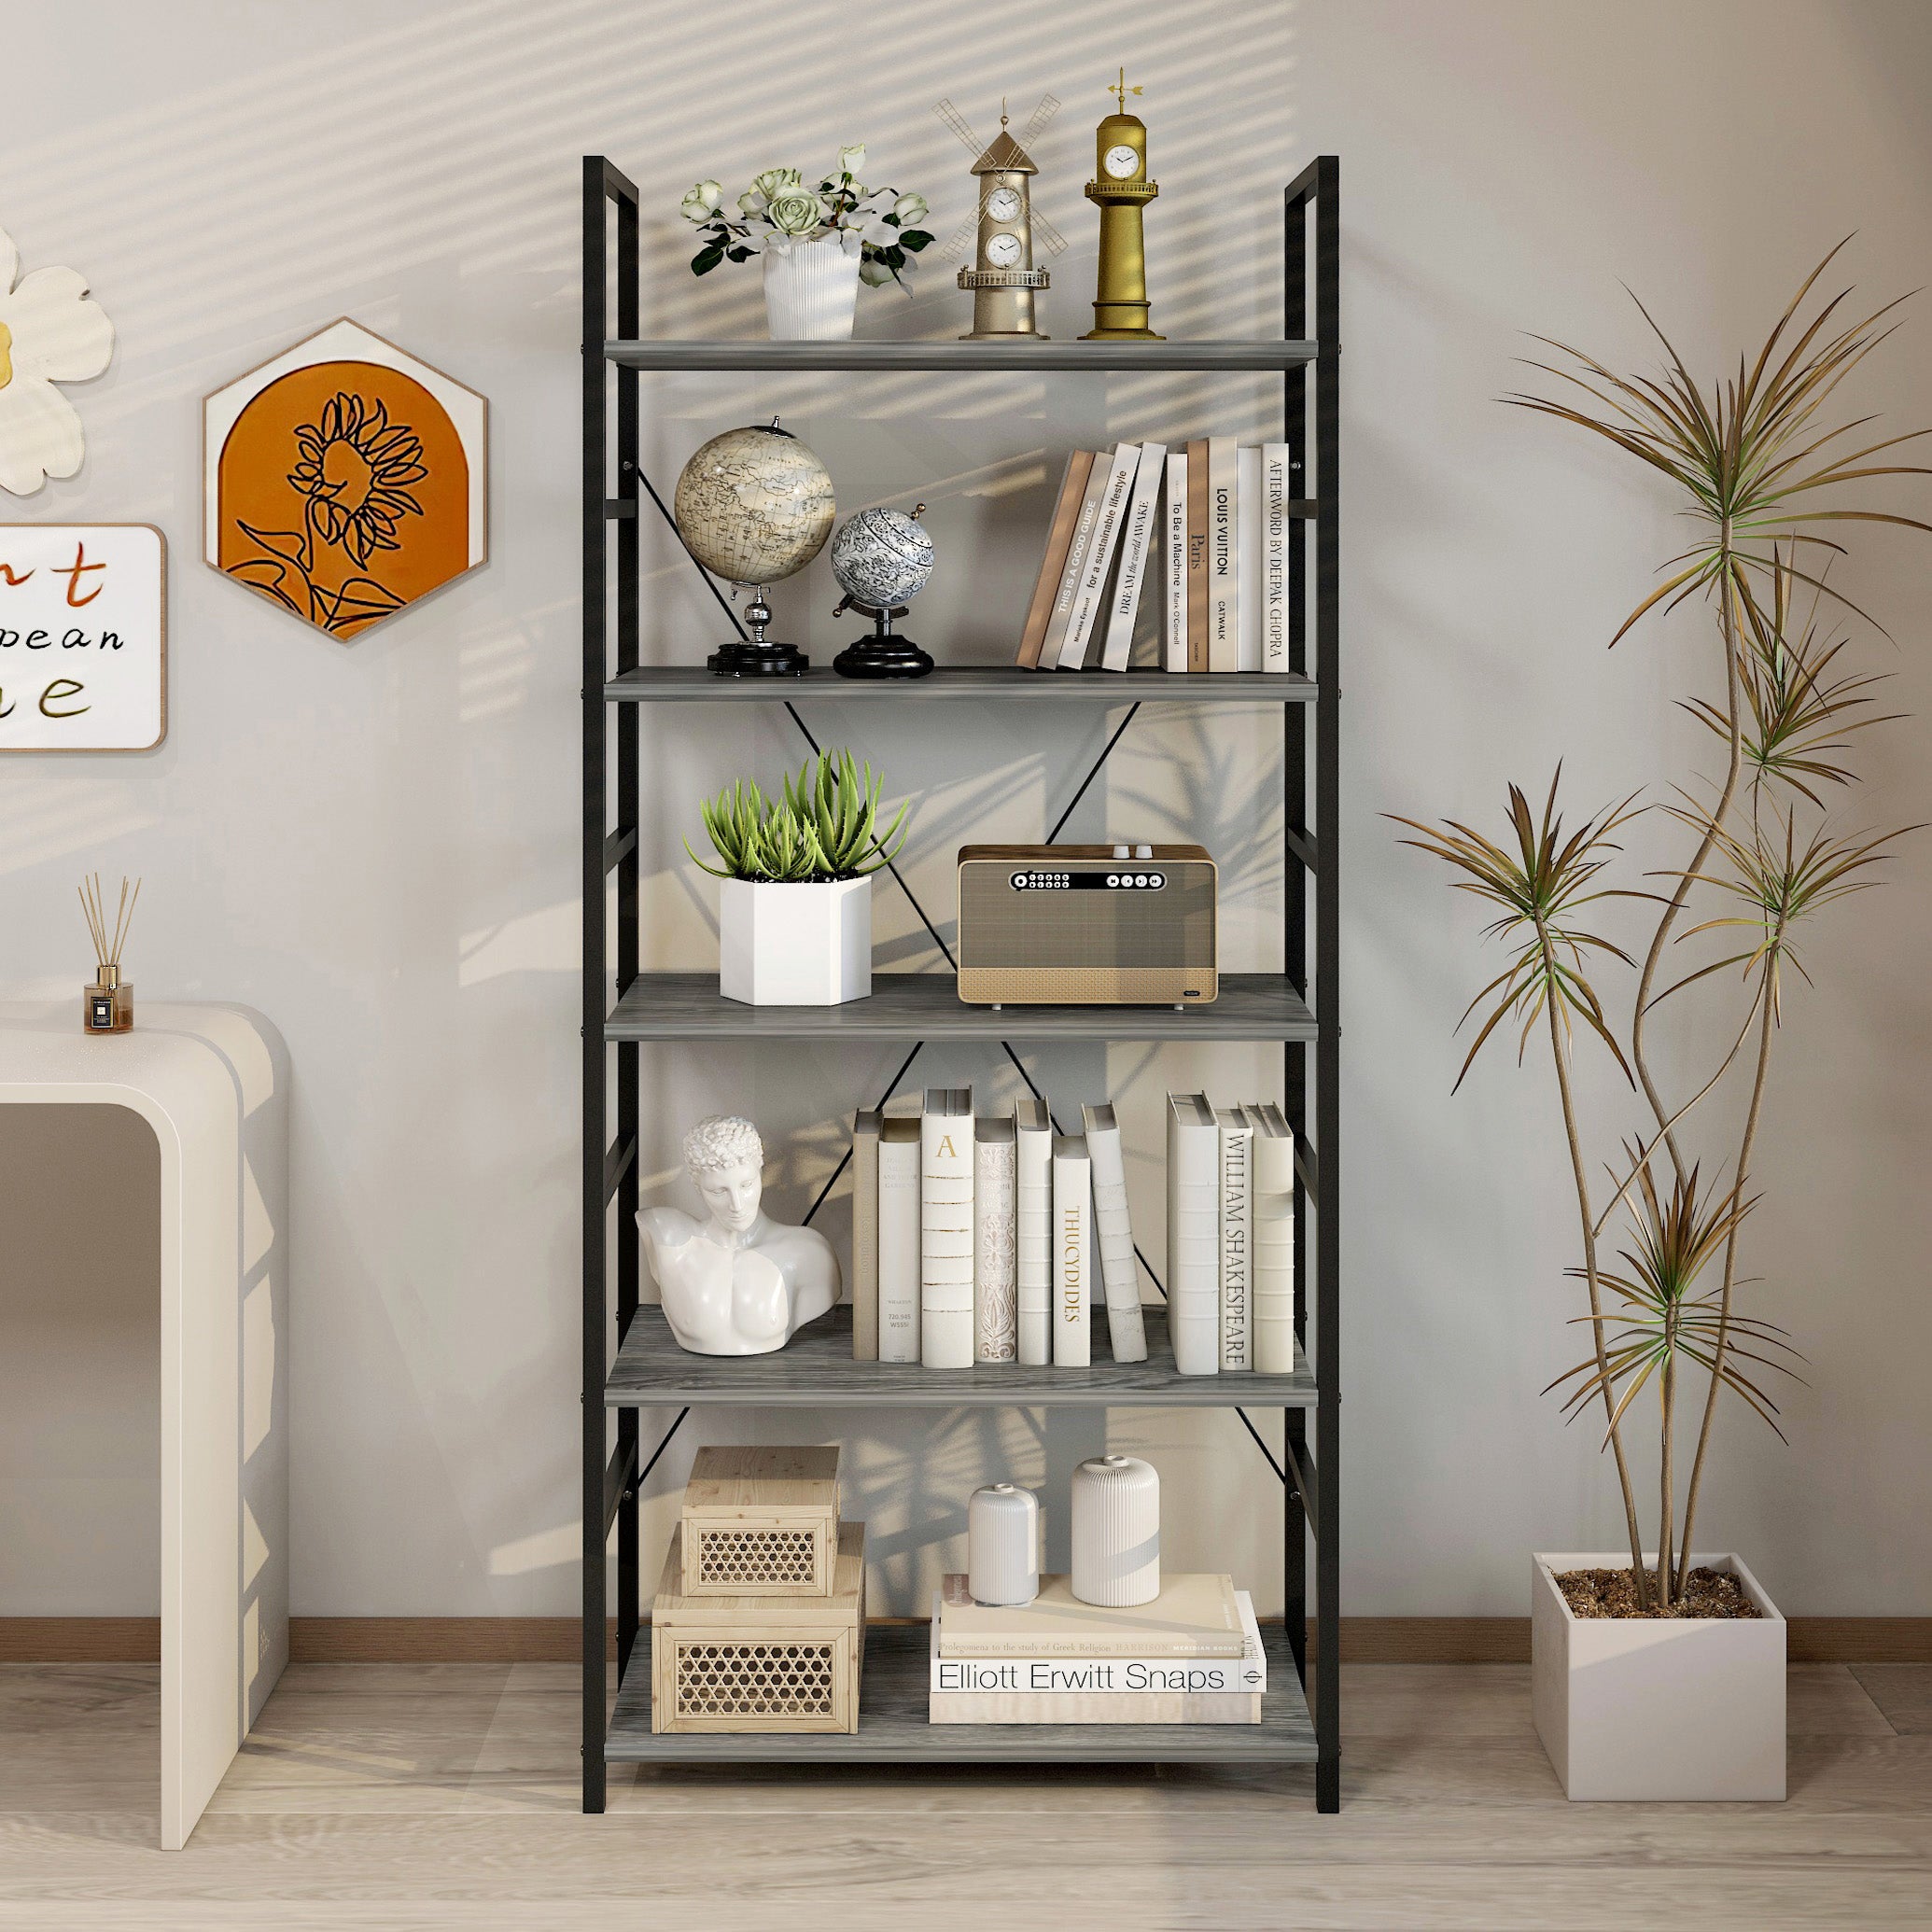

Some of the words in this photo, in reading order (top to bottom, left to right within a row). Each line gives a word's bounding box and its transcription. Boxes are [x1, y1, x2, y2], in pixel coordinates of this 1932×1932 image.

[1172, 502, 1181, 514] To
[1217, 488, 1227, 524] LOUIS
[1270, 459, 1281, 536] AFTERWORD
[1081, 499, 1096, 534] GUIDE
[1086, 575, 1098, 589] for
[1096, 509, 1116, 565] sustainable
[1109, 470, 1127, 508] lifestyle
[1134, 500, 1149, 539] AWAKE
[1172, 518, 1181, 530] Be
[1071, 535, 1086, 567] GOOD
[1132, 539, 1141, 562] world
[1172, 543, 1181, 586] Machine
[1191, 534, 1205, 569] Paris
[1217, 526, 1227, 576] VUITTON
[1270, 540, 1281, 555] BY
[1068, 578, 1074, 589] IS
[1069, 568, 1077, 578] A
[1128, 561, 1137, 574] the
[1270, 559, 1281, 605] DEEPAK
[1057, 590, 1071, 613] THIS
[1120, 574, 1135, 615] DREAM
[1270, 609, 1281, 657] CHOPRA
[936, 1134, 959, 1159] A
[1225, 1135, 1244, 1223] WILLIAM
[1064, 1206, 1080, 1323] THUCYDIDES
[1225, 1228, 1244, 1365] SHAKESPEARE
[939, 1643, 988, 1654] Prolegomena
[1003, 1642, 1015, 1651] the
[1018, 1643, 1039, 1655] study
[1041, 1642, 1050, 1651] of
[1053, 1643, 1075, 1651] Greek
[1079, 1643, 1111, 1654] Religion
[940, 1663, 1018, 1688] Elliott
[1030, 1663, 1114, 1688] Erwitt
[1126, 1663, 1225, 1692] Snaps
